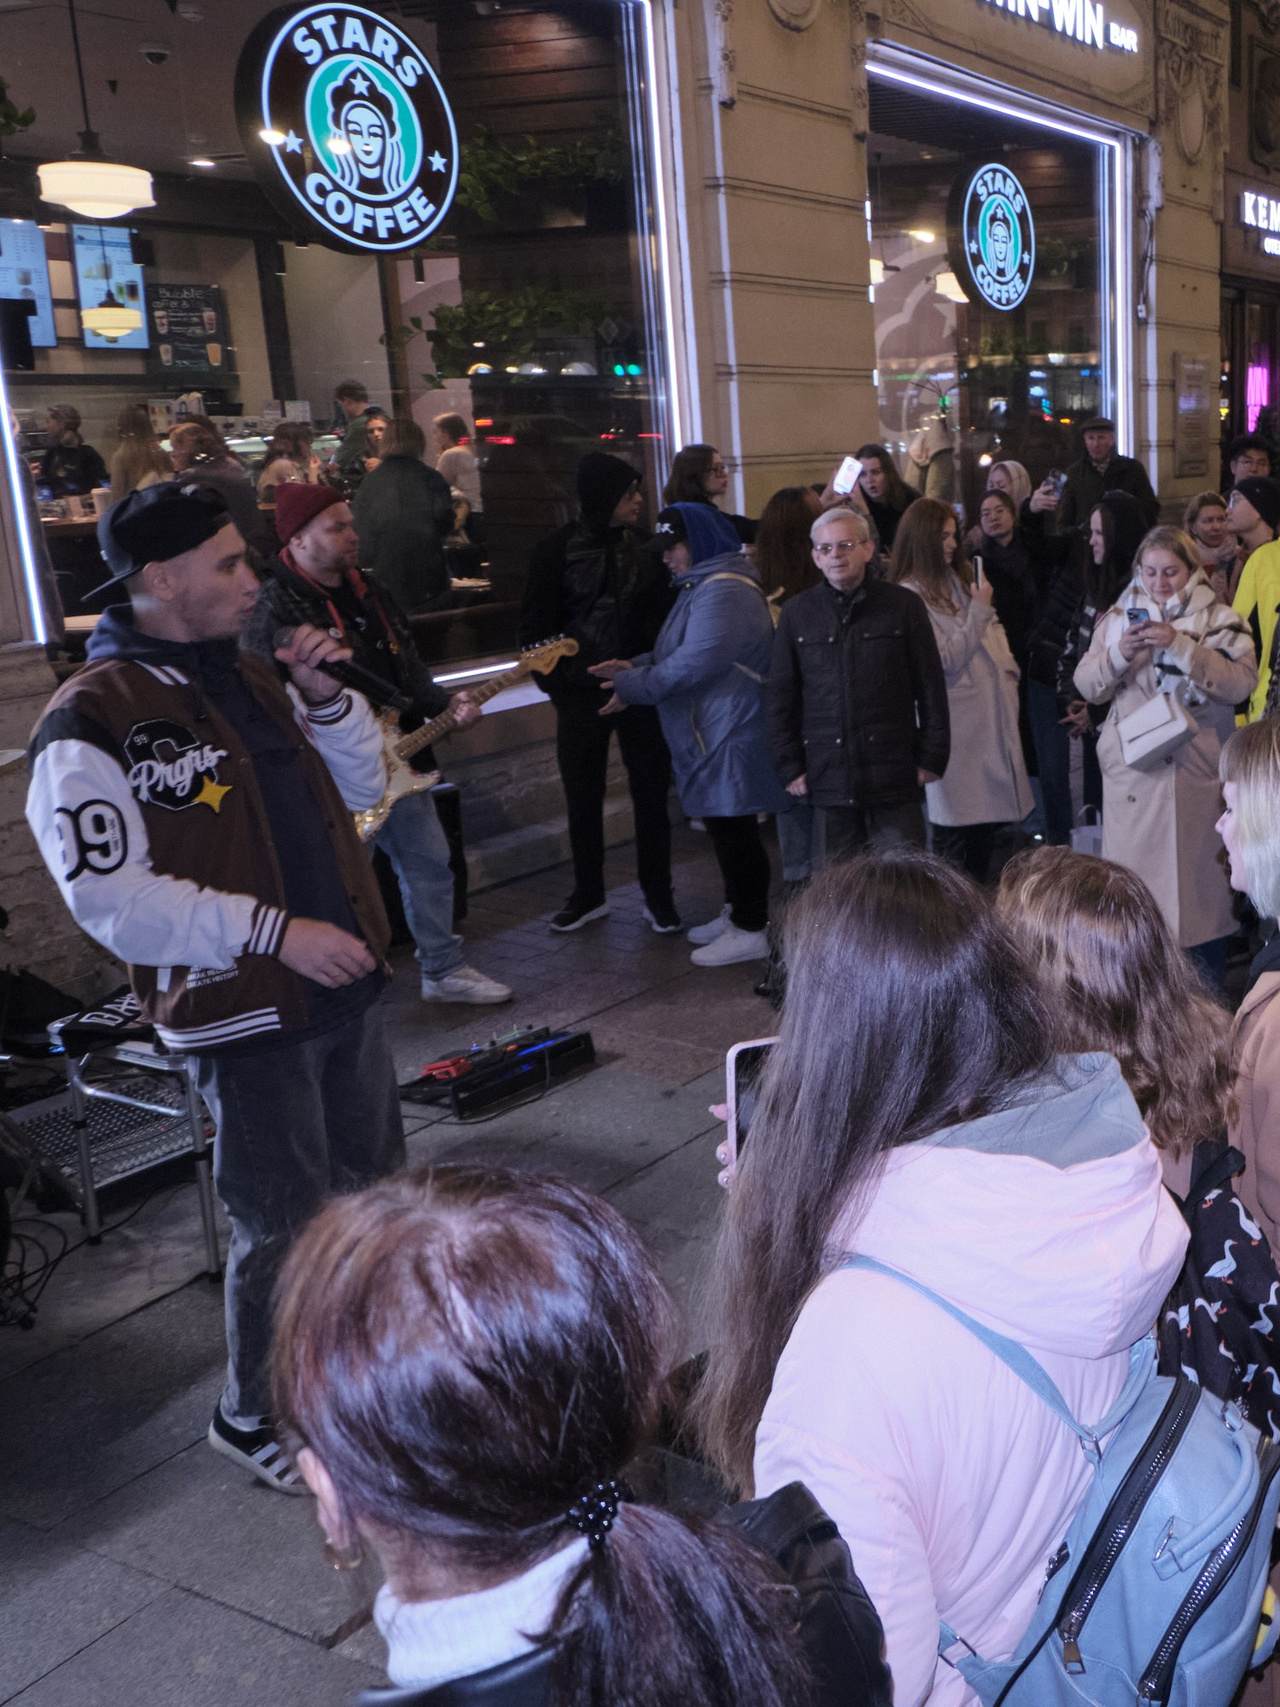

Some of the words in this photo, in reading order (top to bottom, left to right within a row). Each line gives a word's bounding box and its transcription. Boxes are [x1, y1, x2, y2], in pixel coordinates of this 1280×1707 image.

[292, 14, 424, 87] STARS
[984, 0, 1104, 51] -WIN
[1109, 22, 1138, 53] BAR
[305, 172, 437, 239] COFFEE
[976, 171, 1024, 214] STARS
[975, 264, 1025, 305] COFFEE
[133, 733, 149, 746] 99
